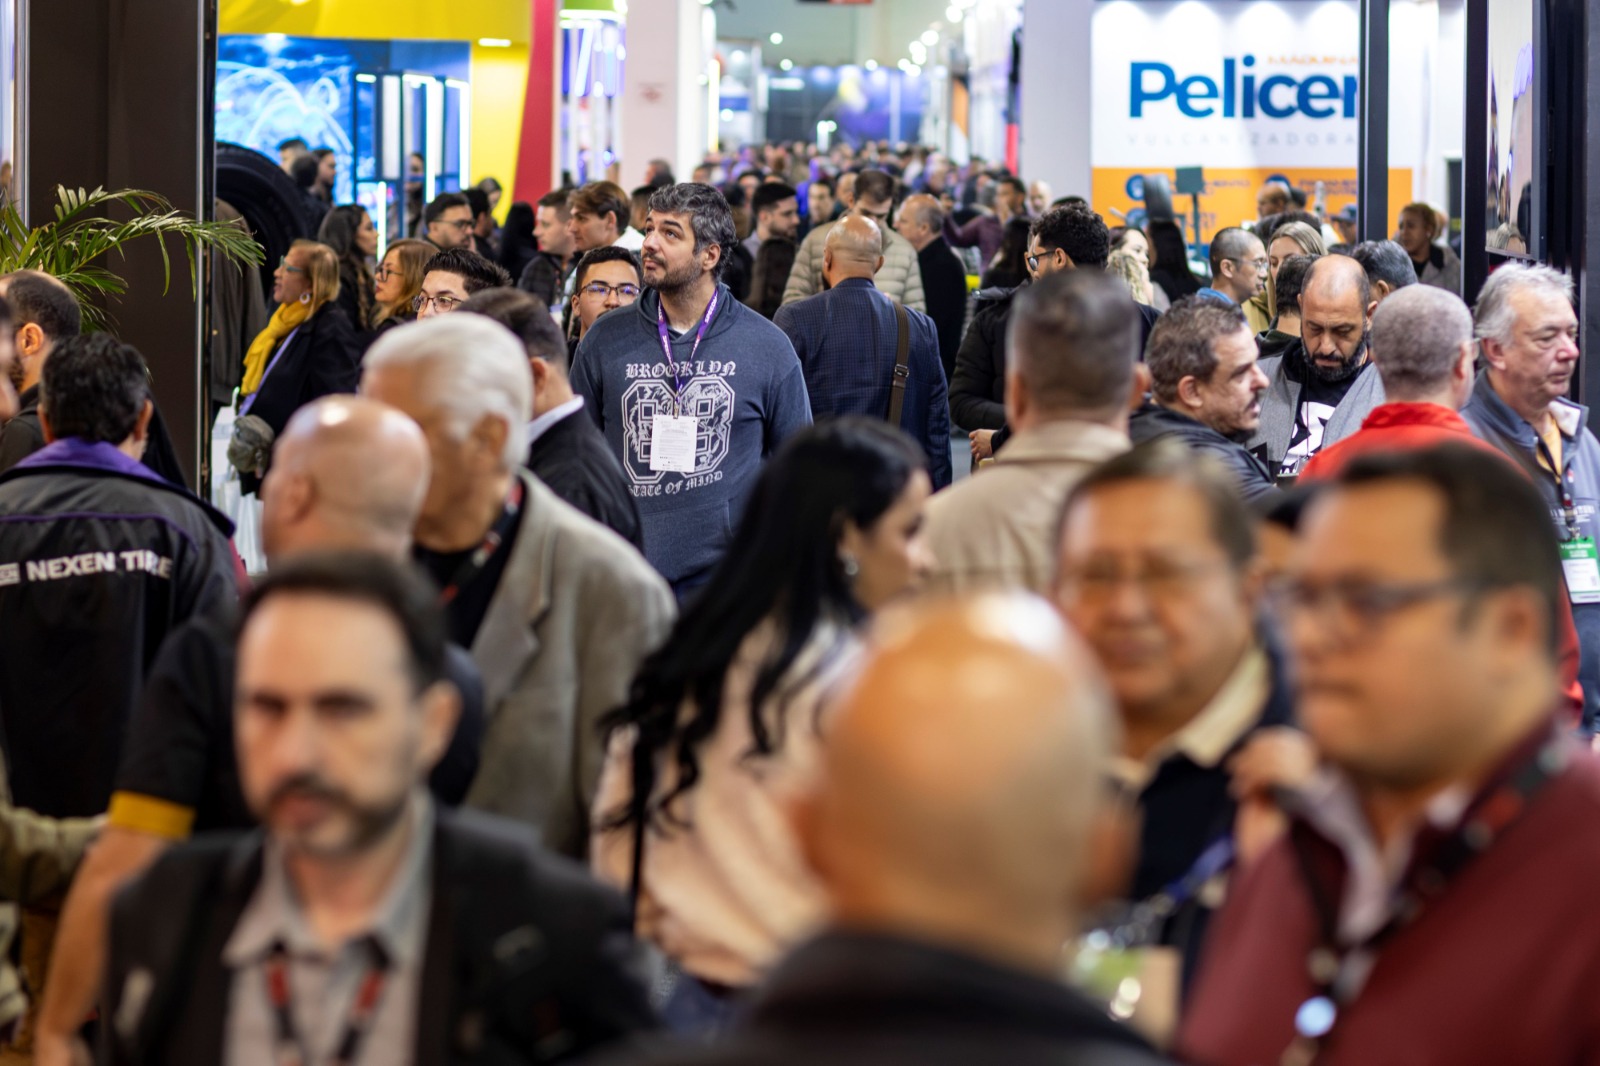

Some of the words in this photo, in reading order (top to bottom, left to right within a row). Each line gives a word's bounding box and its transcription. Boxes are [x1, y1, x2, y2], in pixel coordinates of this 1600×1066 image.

[624, 360, 737, 381] BROOKLYN
[665, 480, 683, 494] OF
[685, 470, 723, 491] MIND
[26, 551, 115, 582] NEXEN
[119, 549, 173, 580] TIRE
